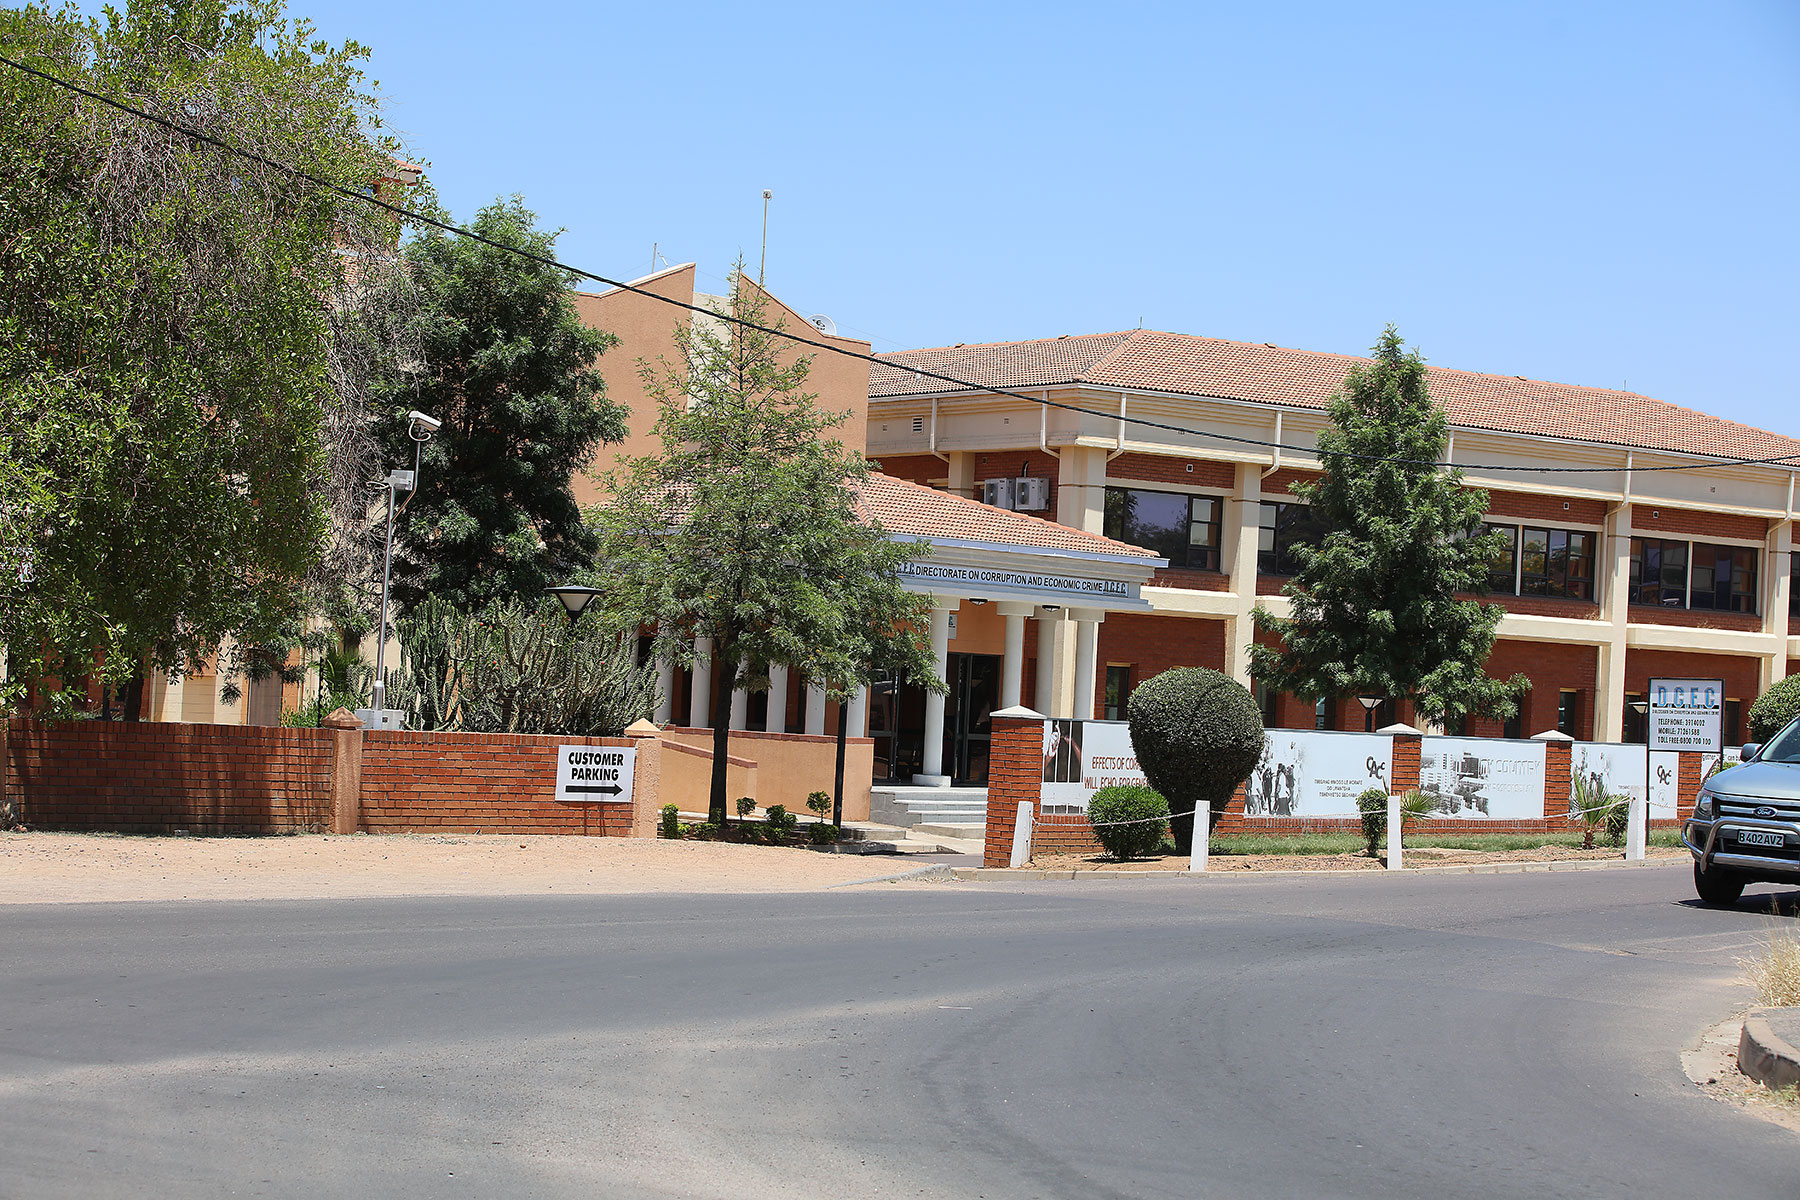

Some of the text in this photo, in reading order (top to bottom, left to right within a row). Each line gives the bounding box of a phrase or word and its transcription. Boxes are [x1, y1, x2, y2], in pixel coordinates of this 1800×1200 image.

[915, 566, 967, 579] DIRECTORATE
[968, 570, 980, 580] ON
[980, 571, 1027, 585] CORRUPTION
[1027, 576, 1043, 586] AND
[1044, 578, 1081, 589] ECONOMIC
[1082, 581, 1103, 591] CRIME
[1658, 718, 1684, 726] TELEPHONE:
[1658, 727, 1676, 735] MOBILE:
[1657, 736, 1668, 744] TOLL
[568, 752, 624, 766] CUSTOMER
[1092, 756, 1116, 769] EFFECTS
[1117, 757, 1125, 770] OF
[571, 767, 619, 781] PARKING
[1084, 777, 1098, 789] WILL
